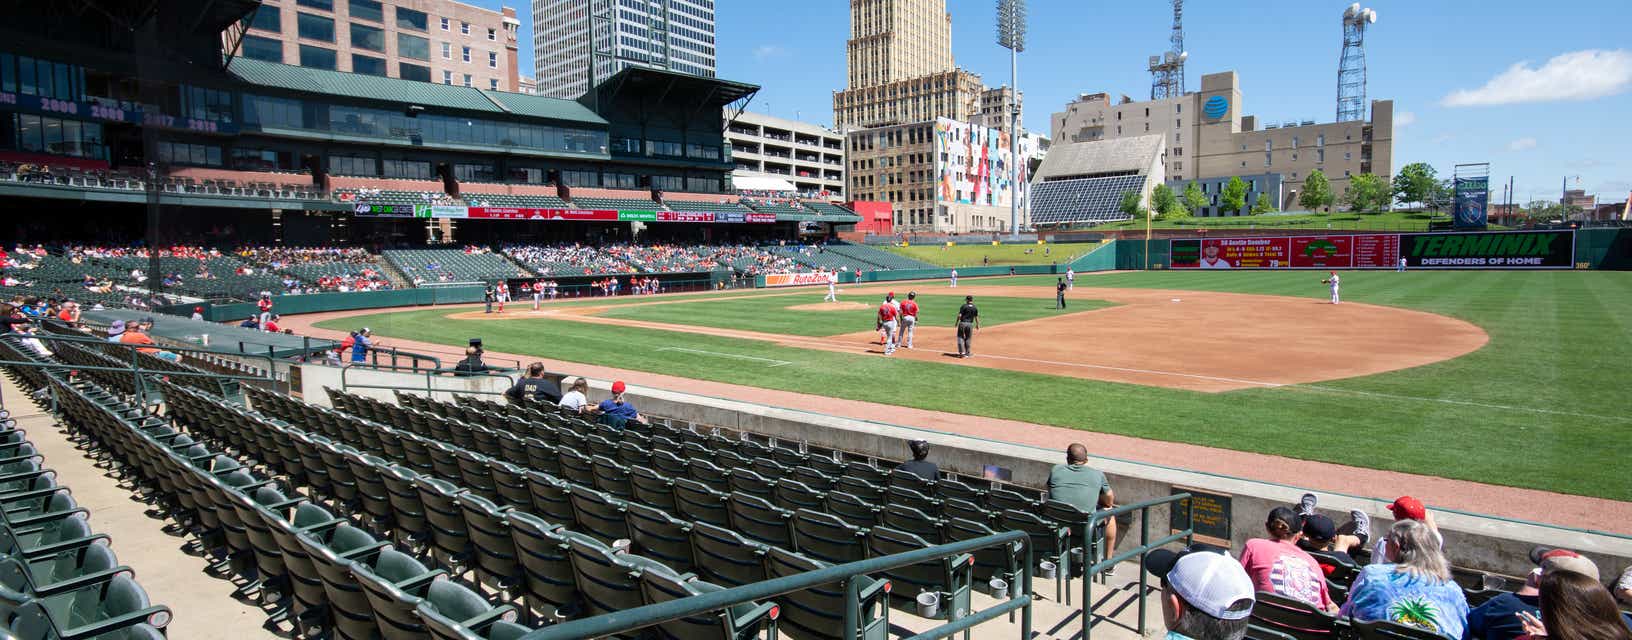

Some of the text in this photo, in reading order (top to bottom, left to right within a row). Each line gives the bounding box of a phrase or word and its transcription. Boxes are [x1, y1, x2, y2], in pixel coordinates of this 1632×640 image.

[1412, 233, 1558, 256] TERMINIX
[1421, 257, 1486, 265] DEFENDERS
[1490, 257, 1505, 265] OF
